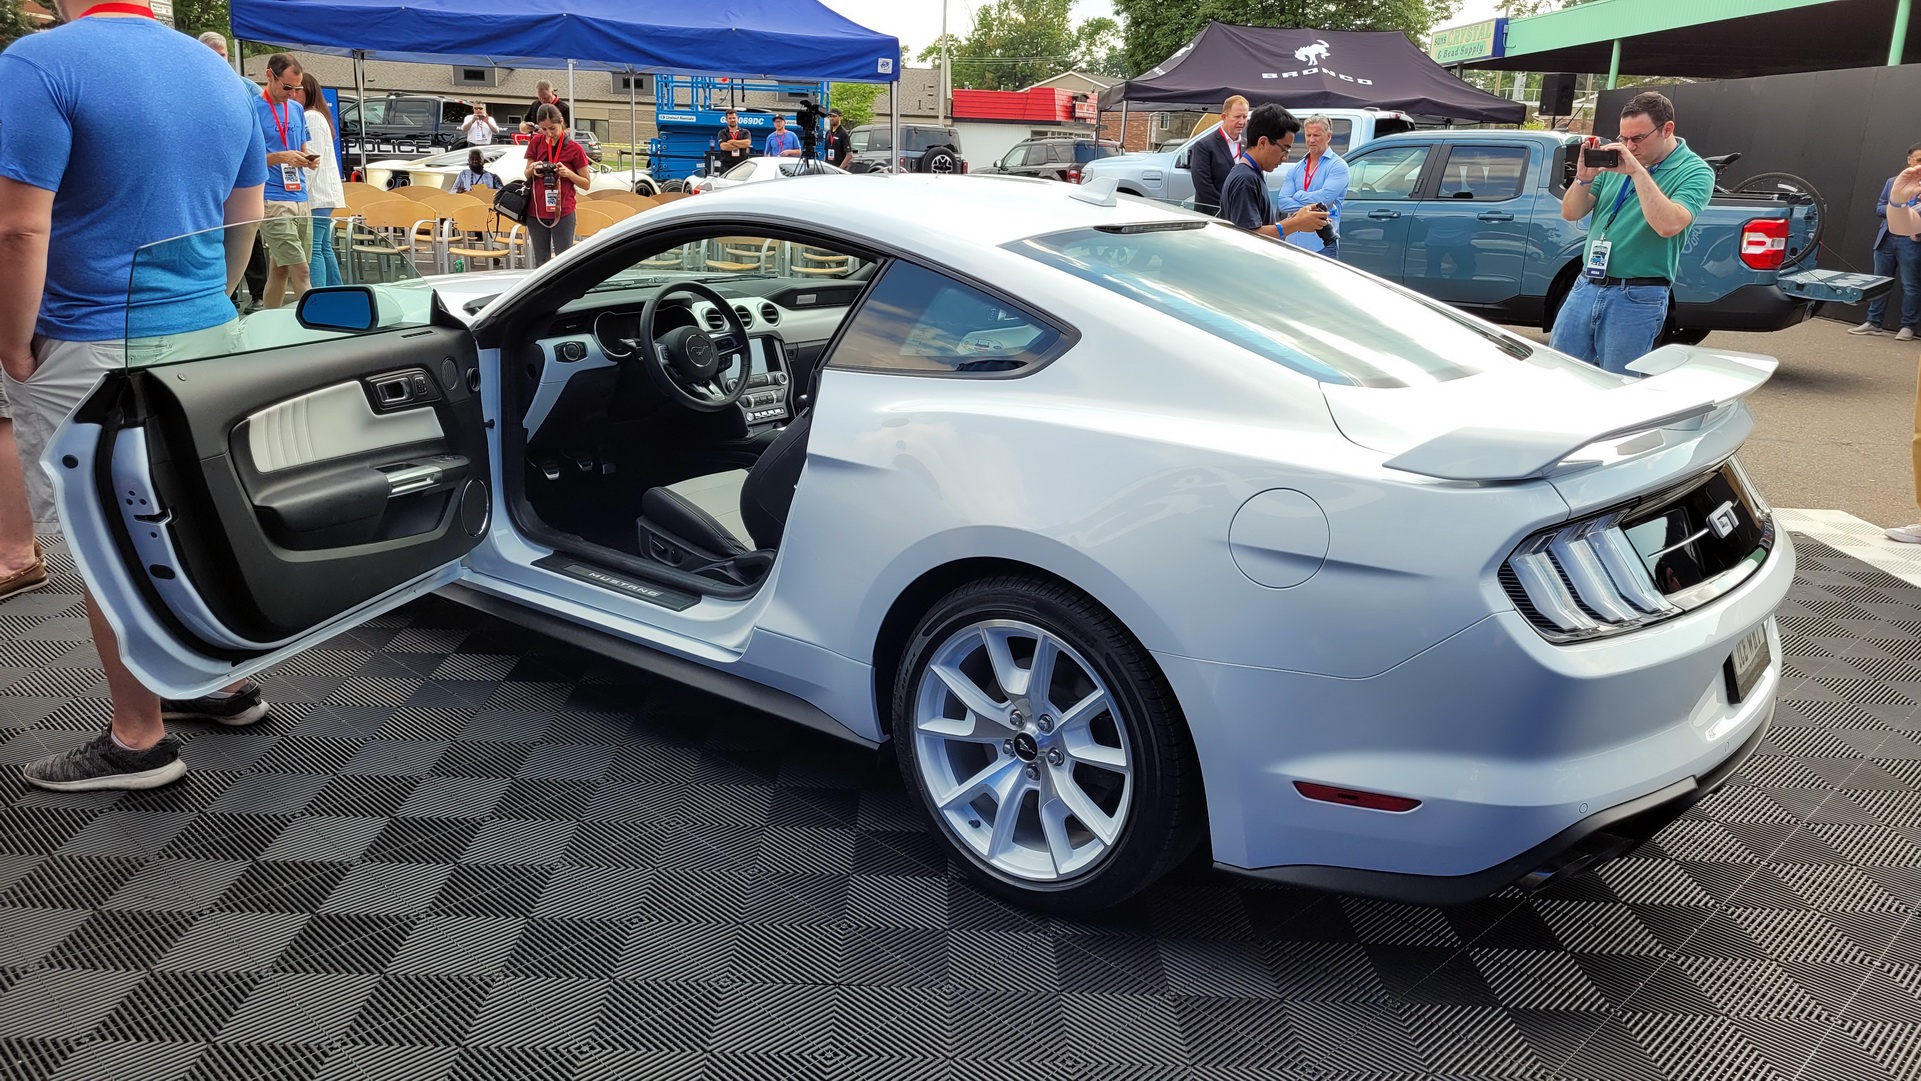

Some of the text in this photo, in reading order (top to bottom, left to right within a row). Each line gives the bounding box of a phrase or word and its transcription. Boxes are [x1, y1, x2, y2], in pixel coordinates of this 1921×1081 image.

[1447, 23, 1492, 46] CRYSTAL
[1443, 47, 1459, 58] Bead
[1460, 43, 1484, 56] Supply
[1261, 67, 1373, 85] BRONCO
[341, 138, 432, 154] POLICE
[1707, 500, 1740, 539] GT
[589, 572, 660, 597] MUSTANG
